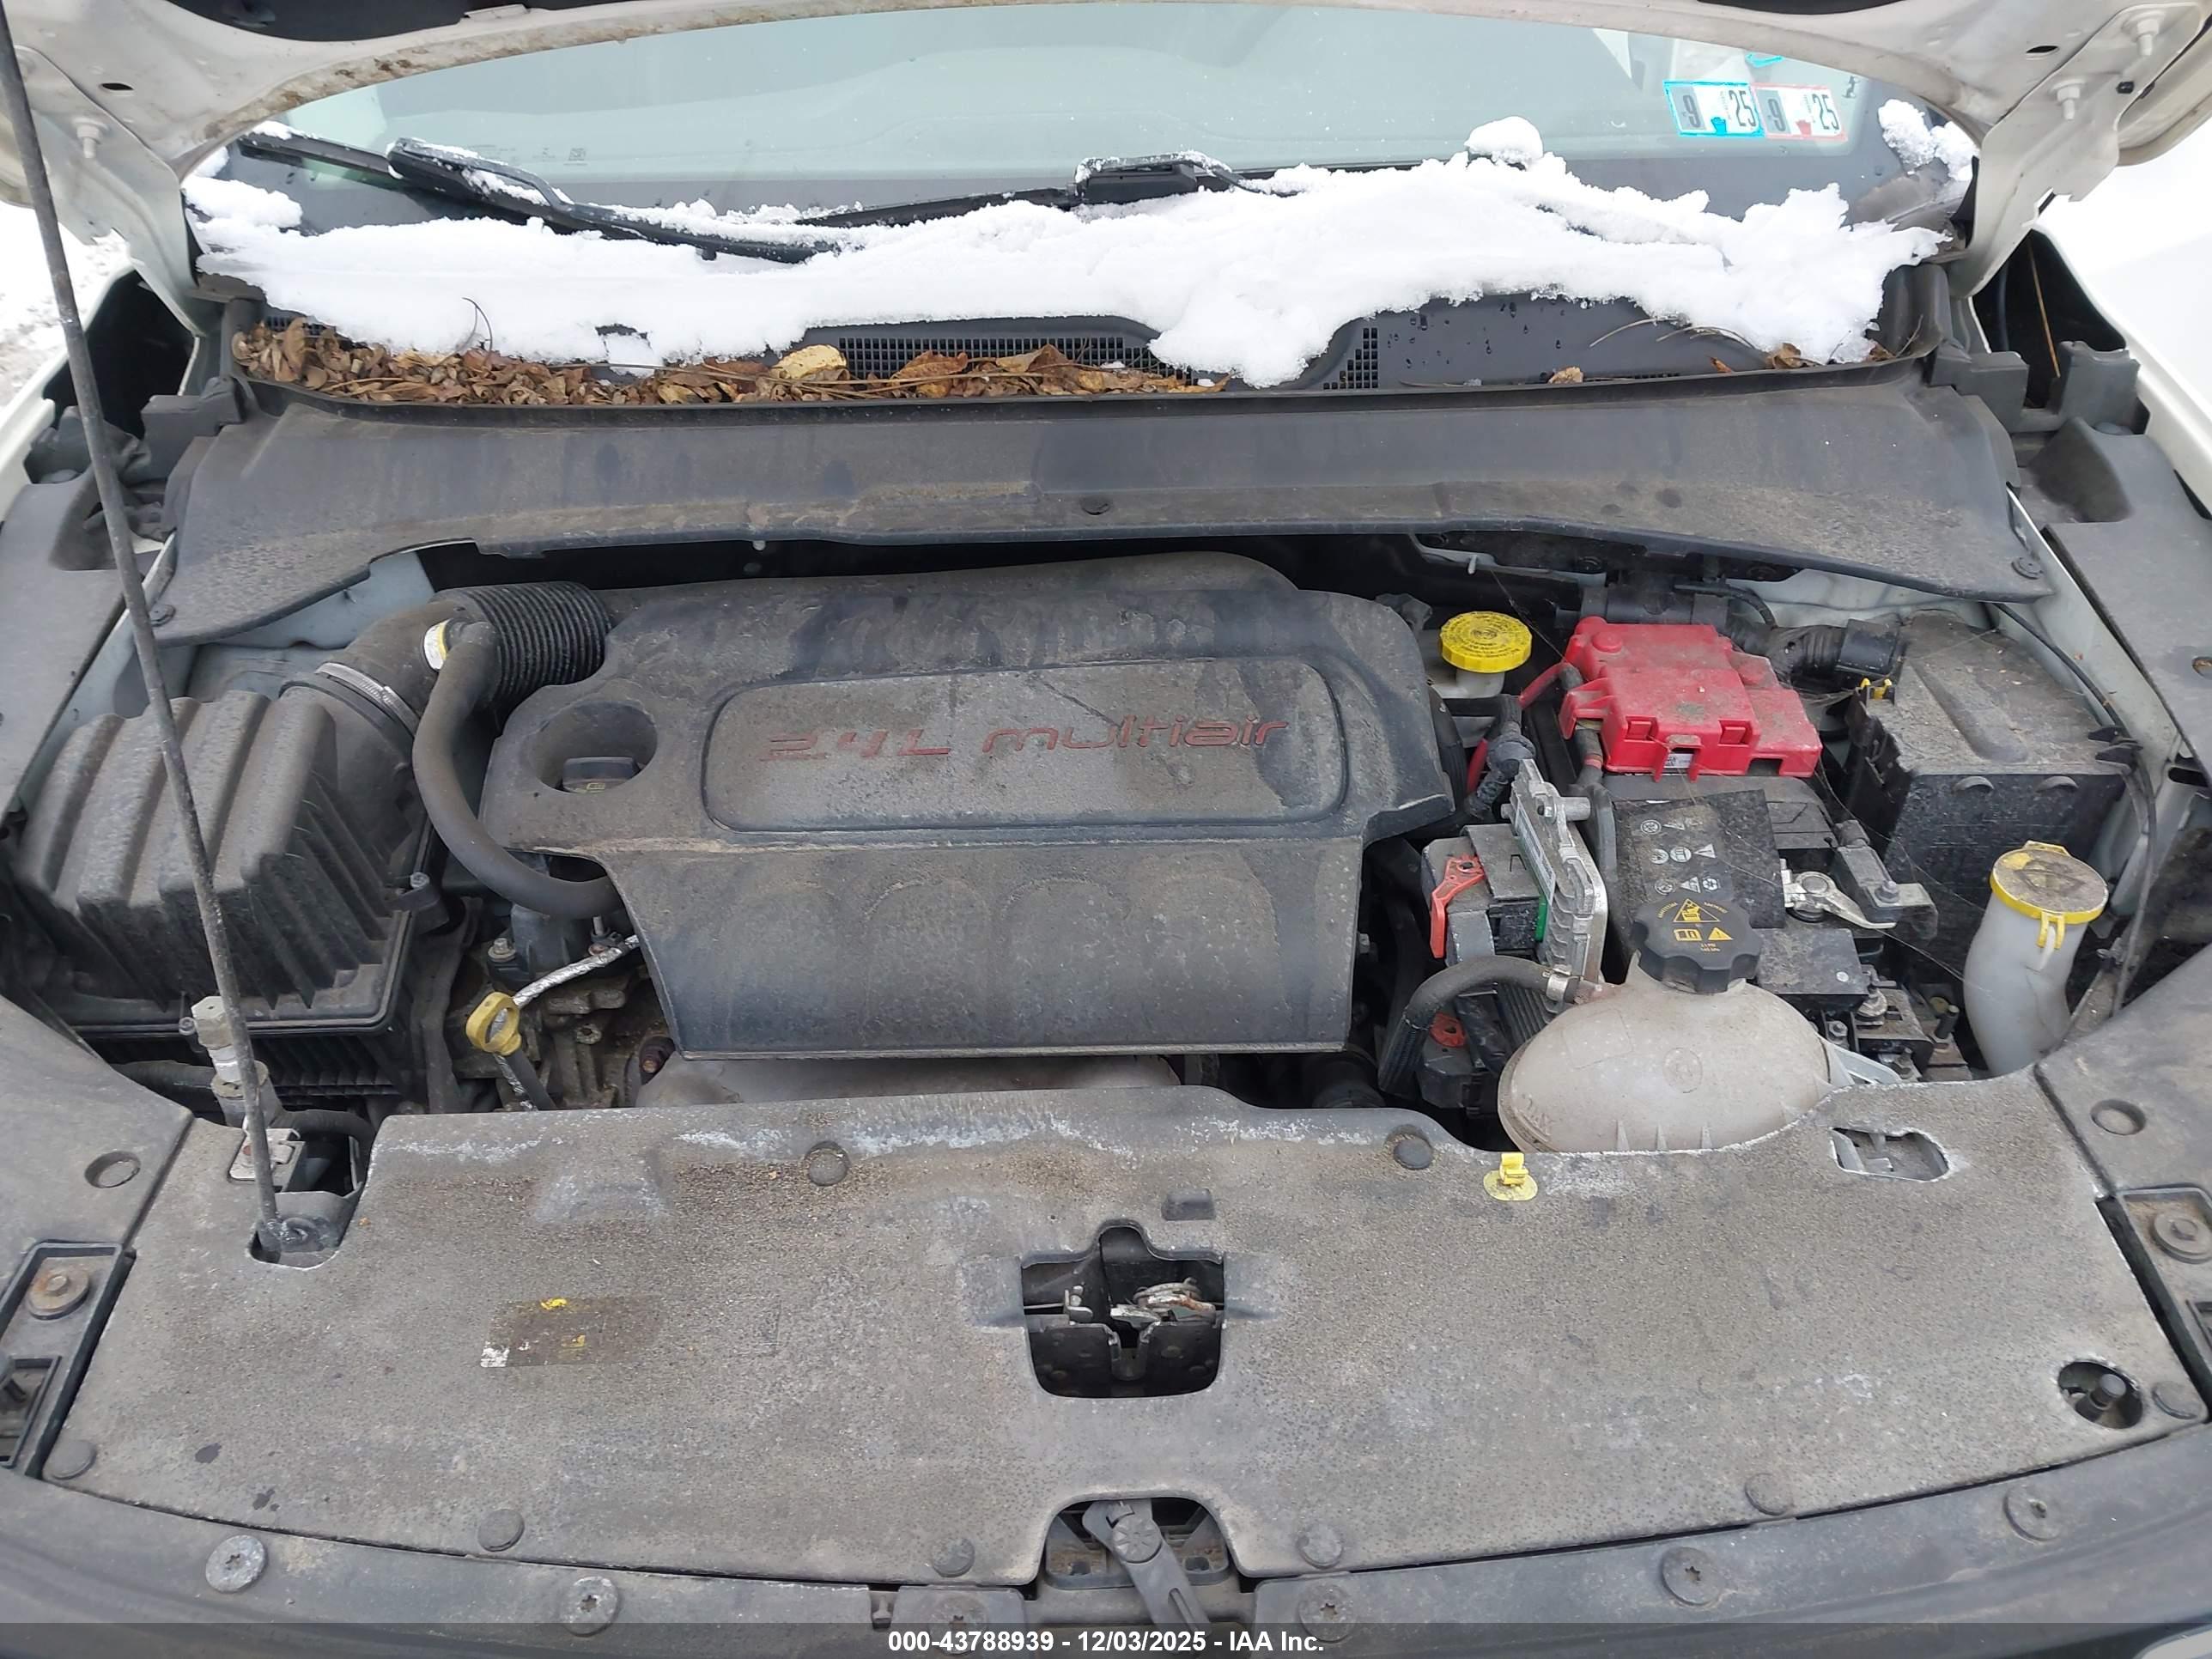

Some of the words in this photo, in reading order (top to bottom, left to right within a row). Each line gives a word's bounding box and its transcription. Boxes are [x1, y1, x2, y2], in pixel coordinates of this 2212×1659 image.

[1729, 89, 1757, 128] 25
[1812, 93, 1840, 131] 25
[981, 714, 1289, 753] multiair
